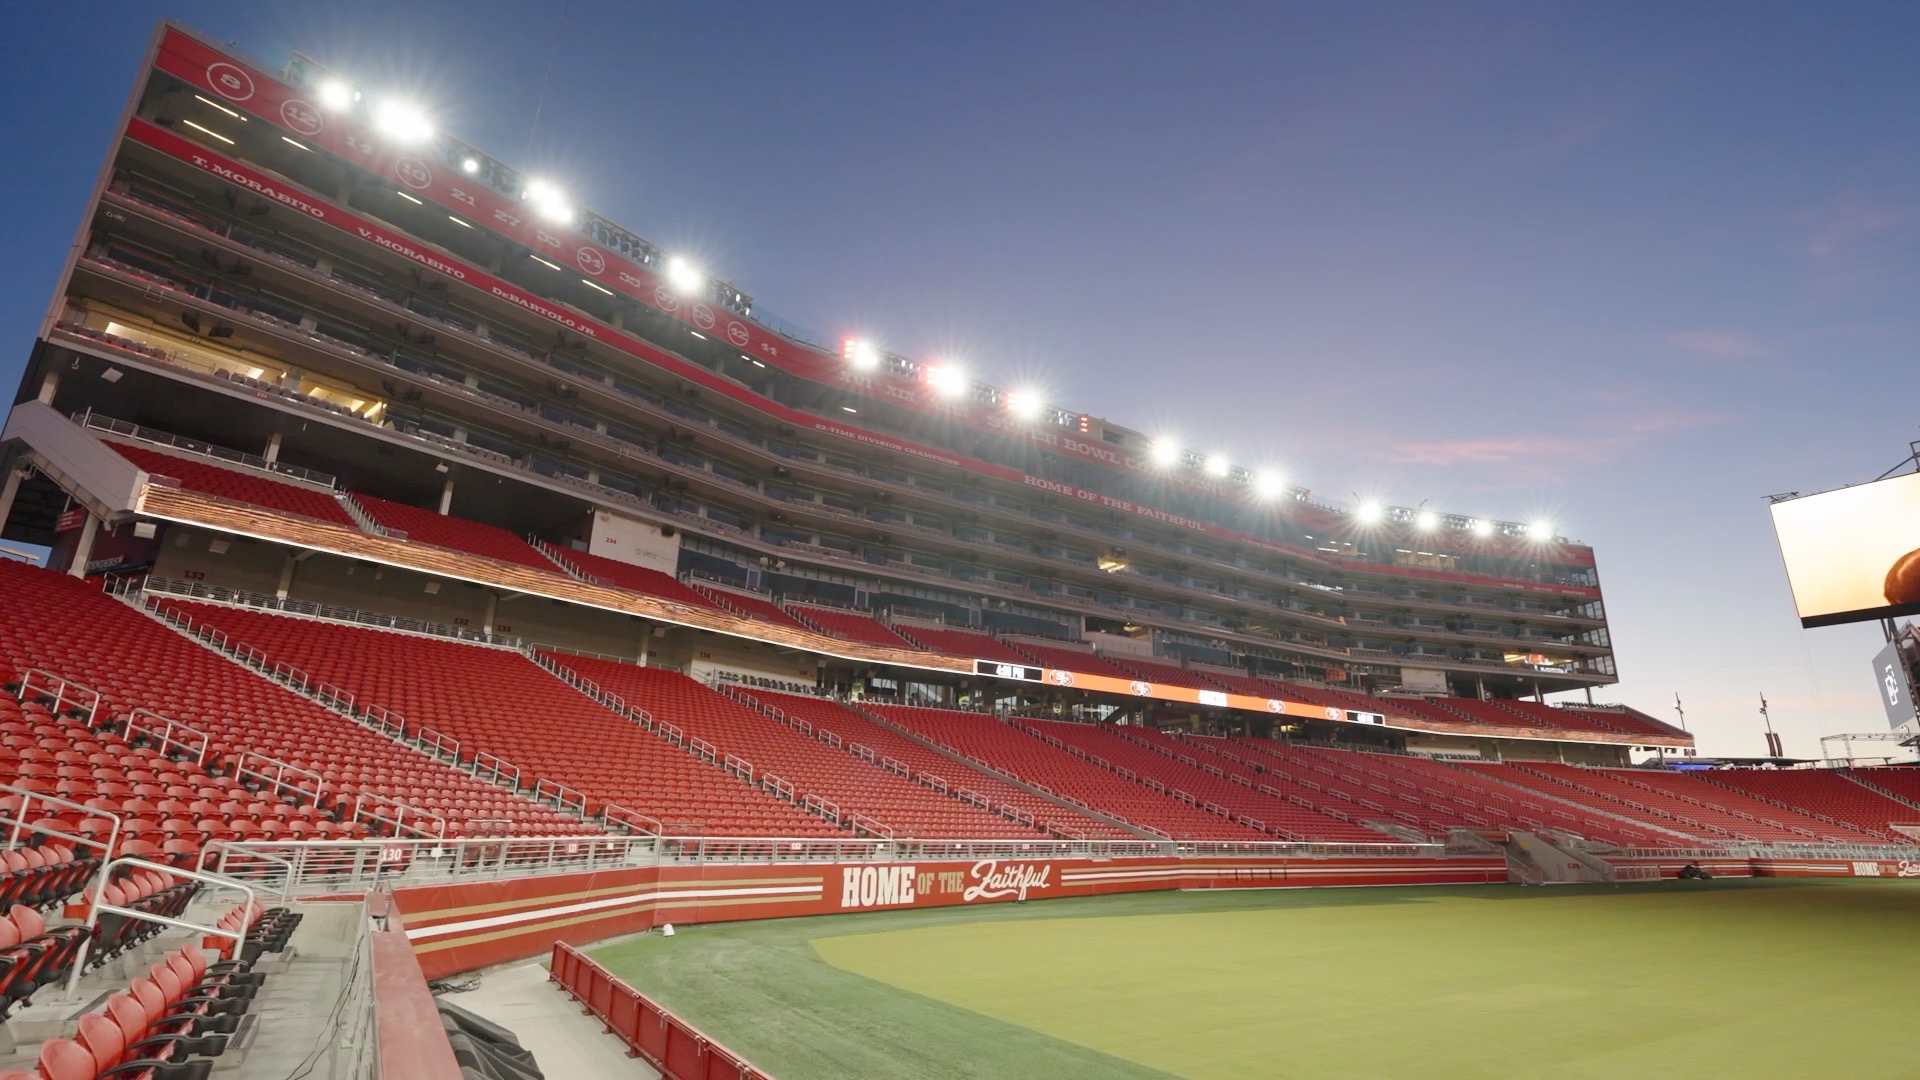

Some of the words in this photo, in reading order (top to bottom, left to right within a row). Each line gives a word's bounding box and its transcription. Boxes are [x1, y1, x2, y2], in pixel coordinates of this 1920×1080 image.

[287, 107, 316, 128] 12
[192, 155, 209, 169] T.
[212, 163, 326, 218] MORABITO
[450, 187, 476, 207] 21
[494, 209, 521, 227] 27
[358, 227, 373, 241] V.
[375, 234, 466, 280] MORABITO
[858, 434, 902, 451] DIVISION
[904, 447, 960, 466] CHAMPIONS
[1064, 437, 1120, 465] BOWL
[1024, 475, 1072, 497] HOME
[1077, 489, 1097, 502] OF
[1101, 496, 1132, 513] THE
[1137, 505, 1205, 532] FAITHFUL
[184, 570, 206, 581] 132
[381, 848, 402, 862] 130
[1852, 861, 1881, 876] HOME
[841, 866, 916, 908] HOME
[917, 872, 934, 895] OF
[938, 871, 965, 894] THE
[963, 859, 1050, 902] Faithful
